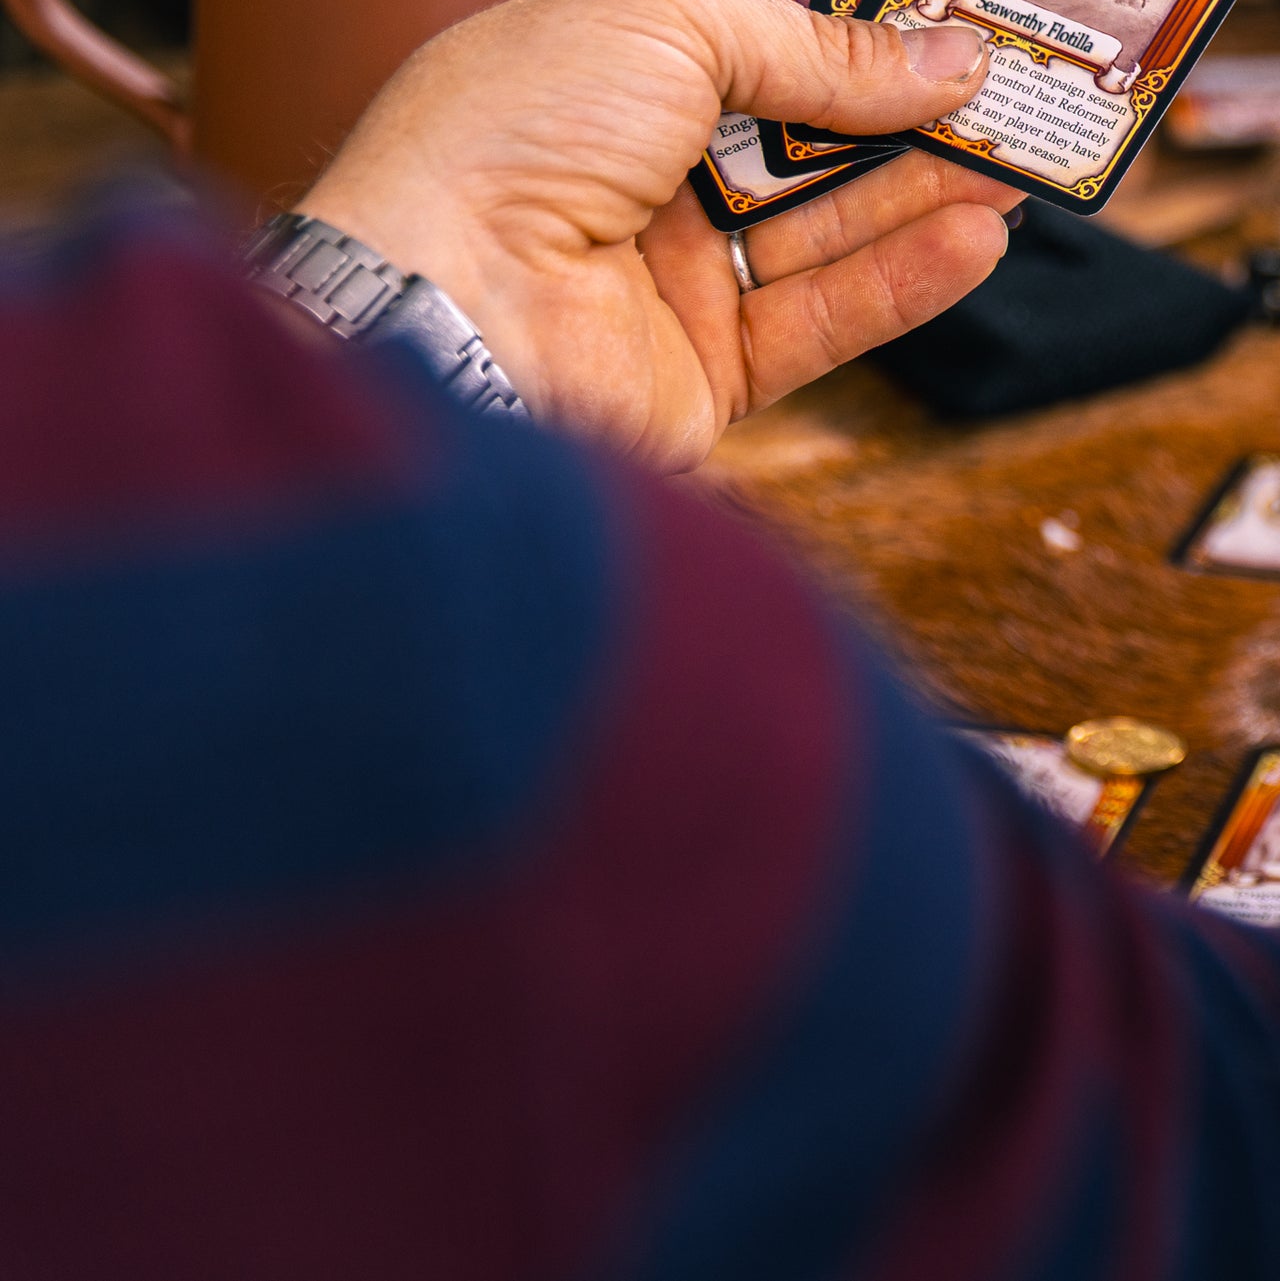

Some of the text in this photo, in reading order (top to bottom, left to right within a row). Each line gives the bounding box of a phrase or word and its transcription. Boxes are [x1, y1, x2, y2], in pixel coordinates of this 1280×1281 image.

[1046, 21, 1094, 54] Flotilla
[992, 73, 1118, 130] control has Reformed
[993, 52, 1007, 66] in
[1008, 59, 1028, 74] the
[1029, 68, 1086, 98] campaign
[1087, 93, 1128, 116] season
[947, 110, 1071, 169] this campaign season.
[981, 87, 1013, 107] army
[1013, 101, 1034, 115] can
[1035, 107, 1110, 147] immediately
[982, 107, 1101, 162] any player they have
[716, 134, 760, 159] seaso
